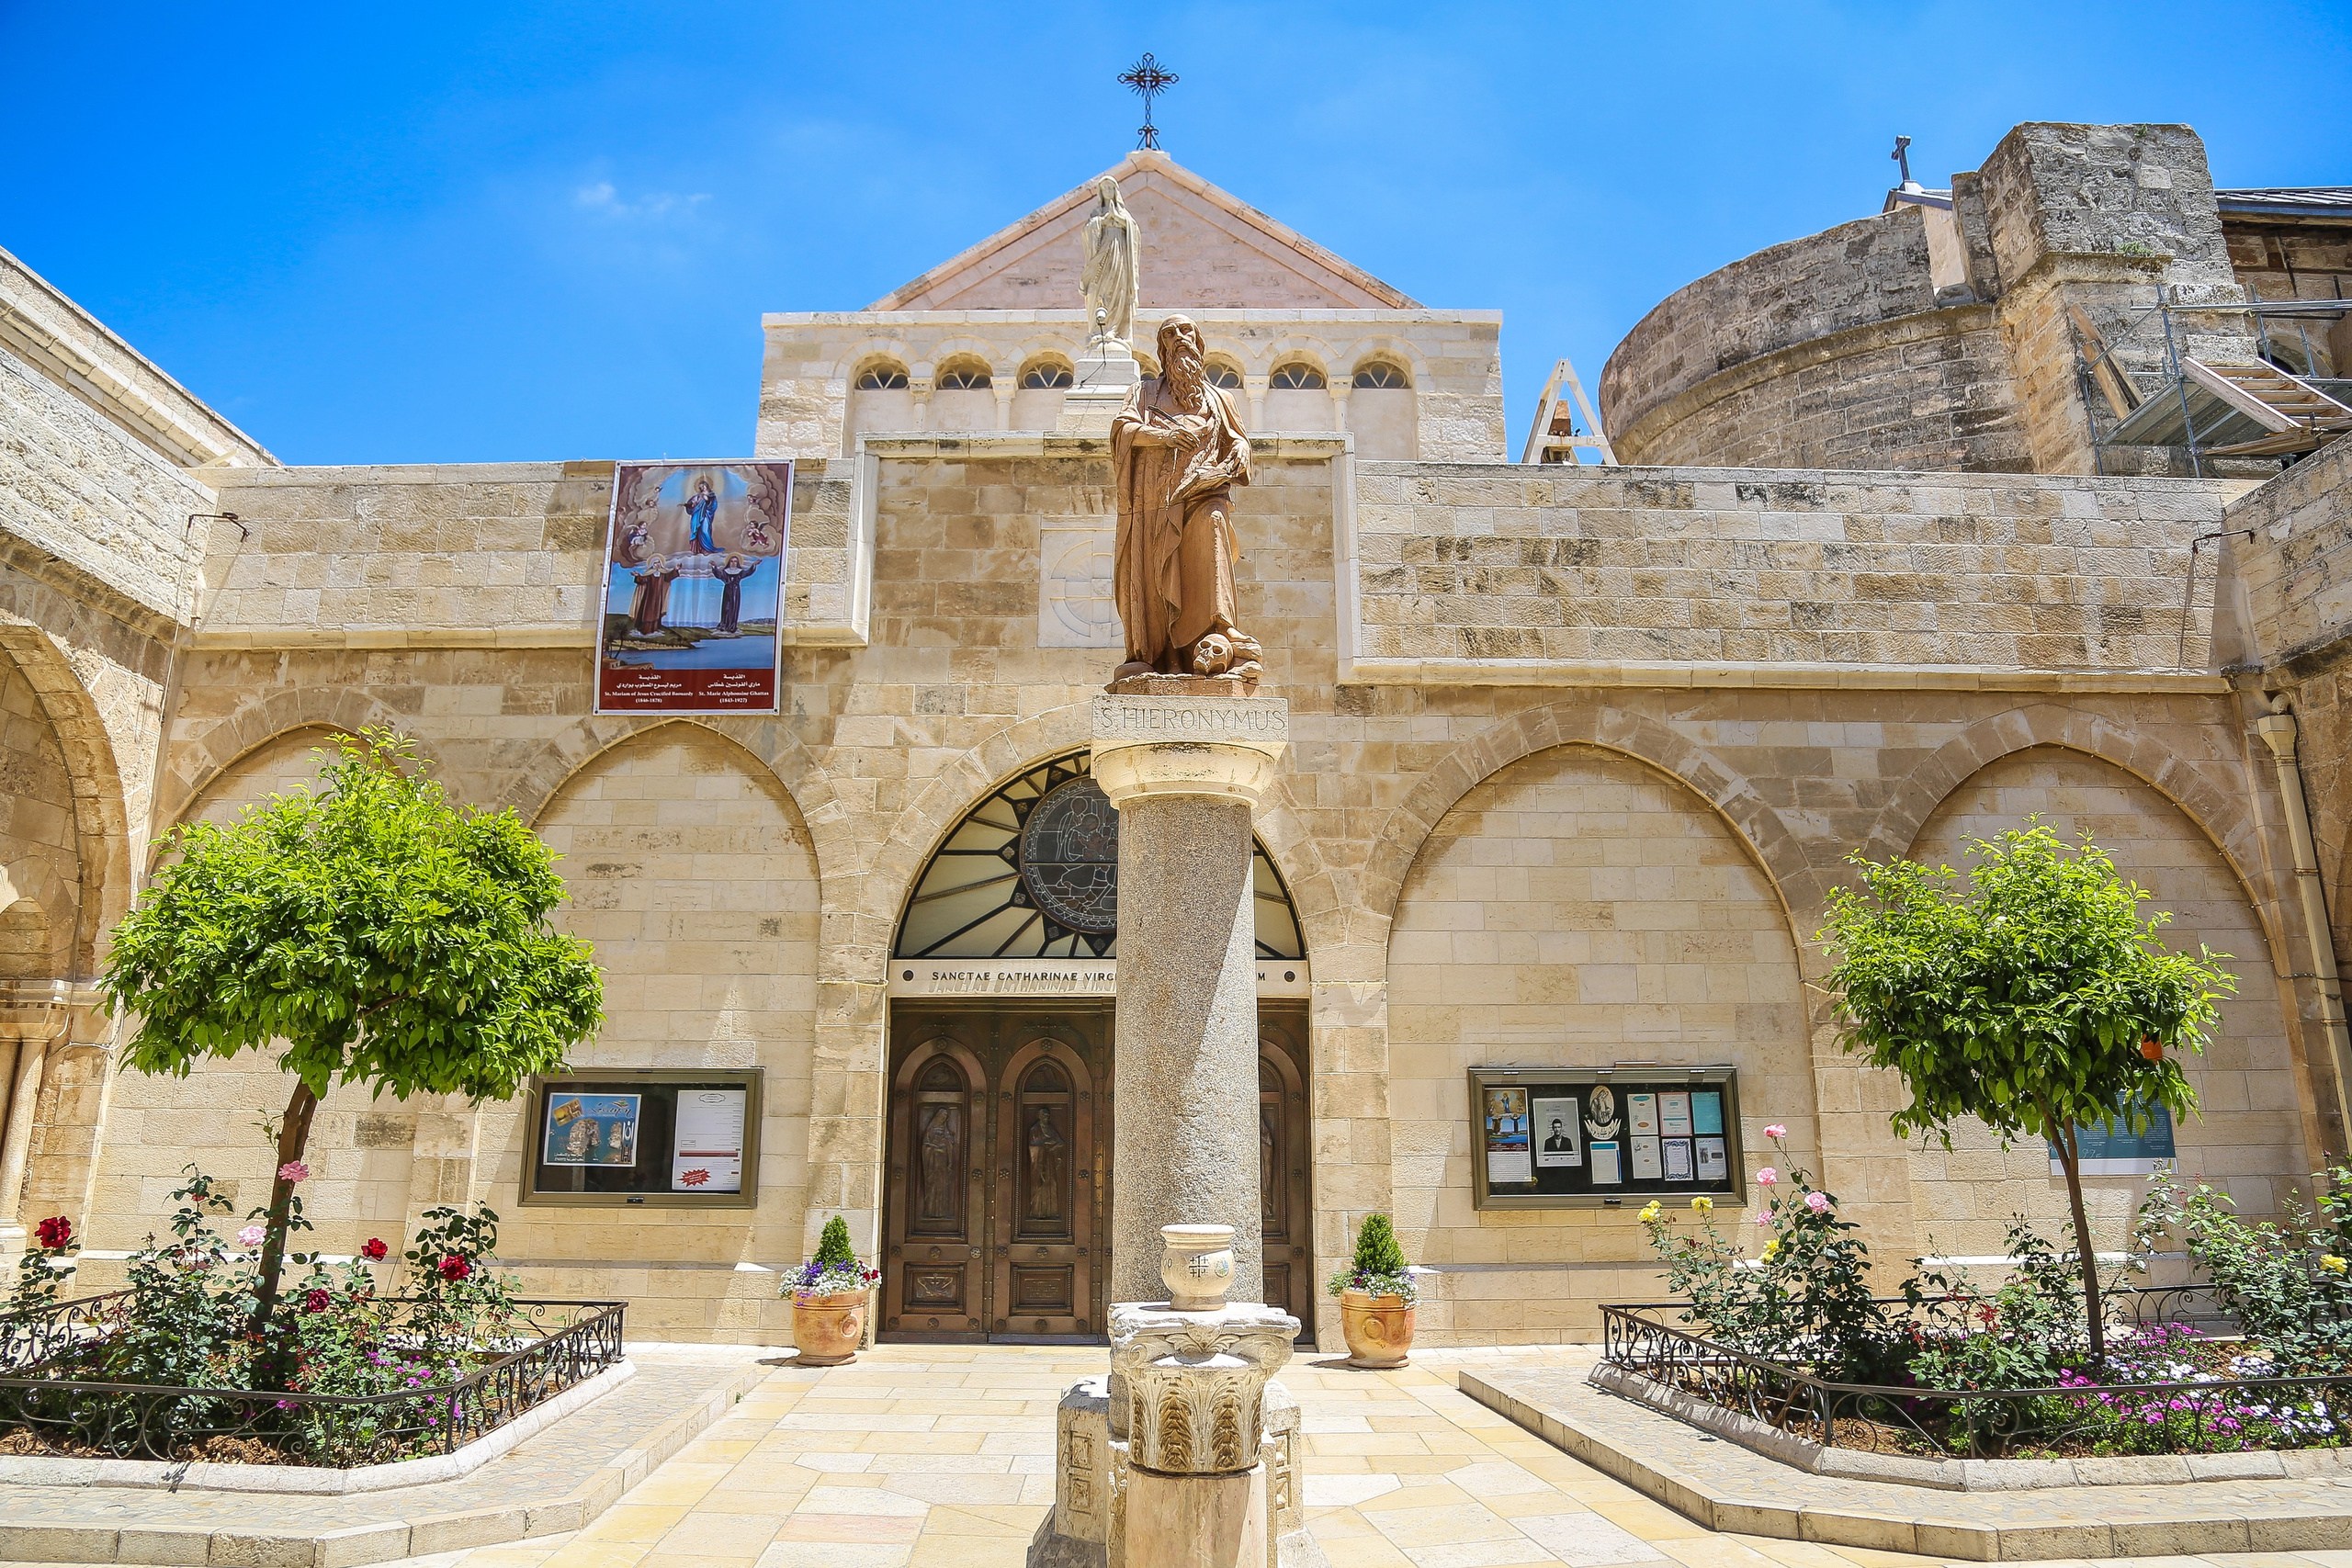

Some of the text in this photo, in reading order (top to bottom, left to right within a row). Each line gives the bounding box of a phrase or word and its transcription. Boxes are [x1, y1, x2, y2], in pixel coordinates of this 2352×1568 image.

[1121, 706, 1286, 731] HIERONYMUS
[932, 971, 990, 982] SANCTAE
[997, 971, 1078, 982] CATHARINAE
